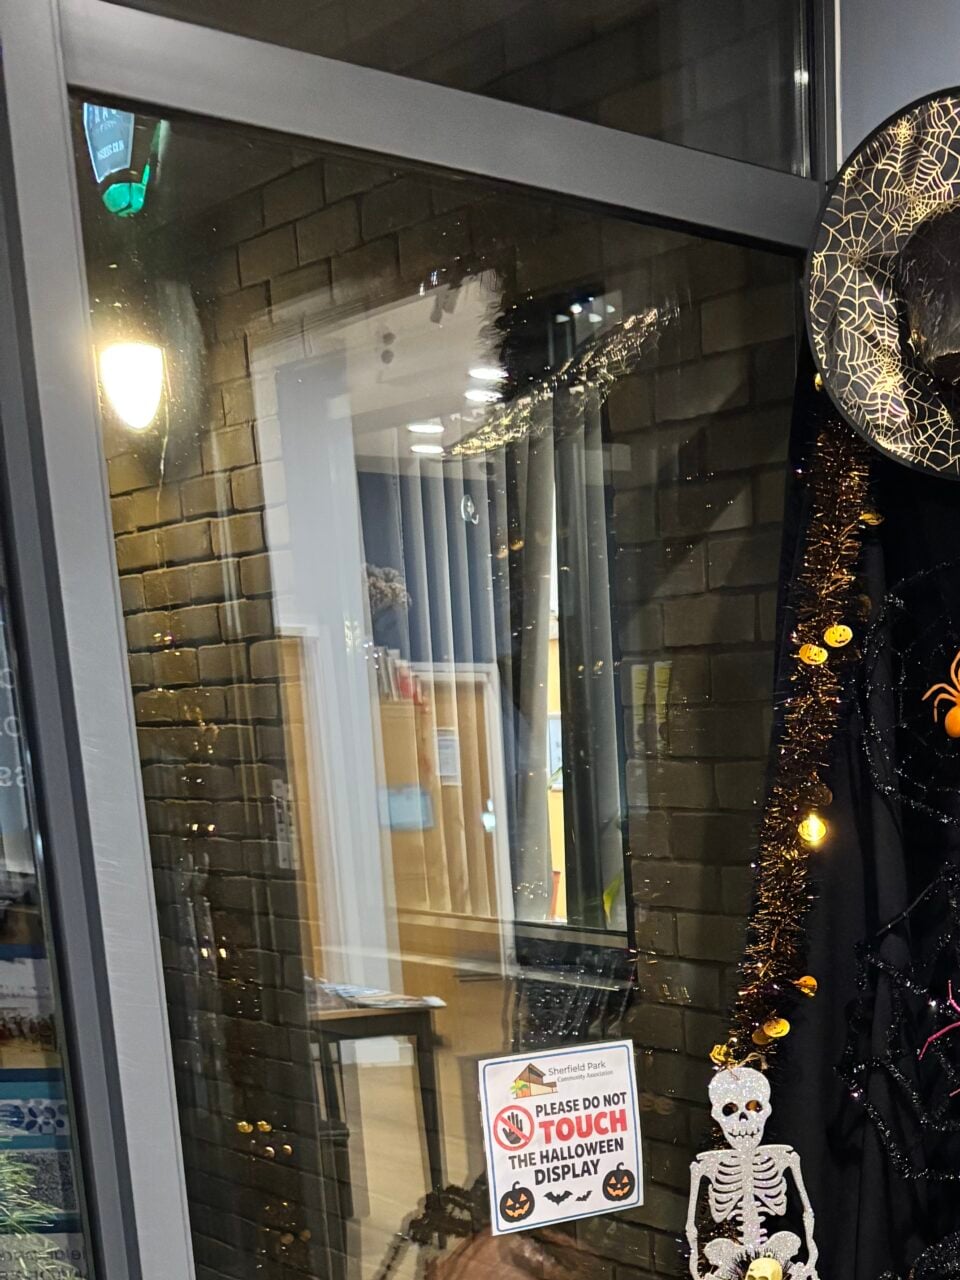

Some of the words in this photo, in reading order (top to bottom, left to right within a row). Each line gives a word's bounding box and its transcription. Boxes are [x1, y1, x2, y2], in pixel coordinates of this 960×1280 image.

[548, 1062, 585, 1076] Sherfield
[588, 1061, 606, 1070] Park
[557, 1073, 586, 1083] Community
[586, 1069, 614, 1079] Association
[535, 1099, 580, 1118] PLEASE
[583, 1097, 600, 1110] DO
[603, 1092, 628, 1107] NOT
[538, 1108, 628, 1145] TOUCH
[508, 1151, 537, 1170] THE
[539, 1137, 625, 1165] HALLOWEEN
[534, 1158, 601, 1186] DISPLAY
